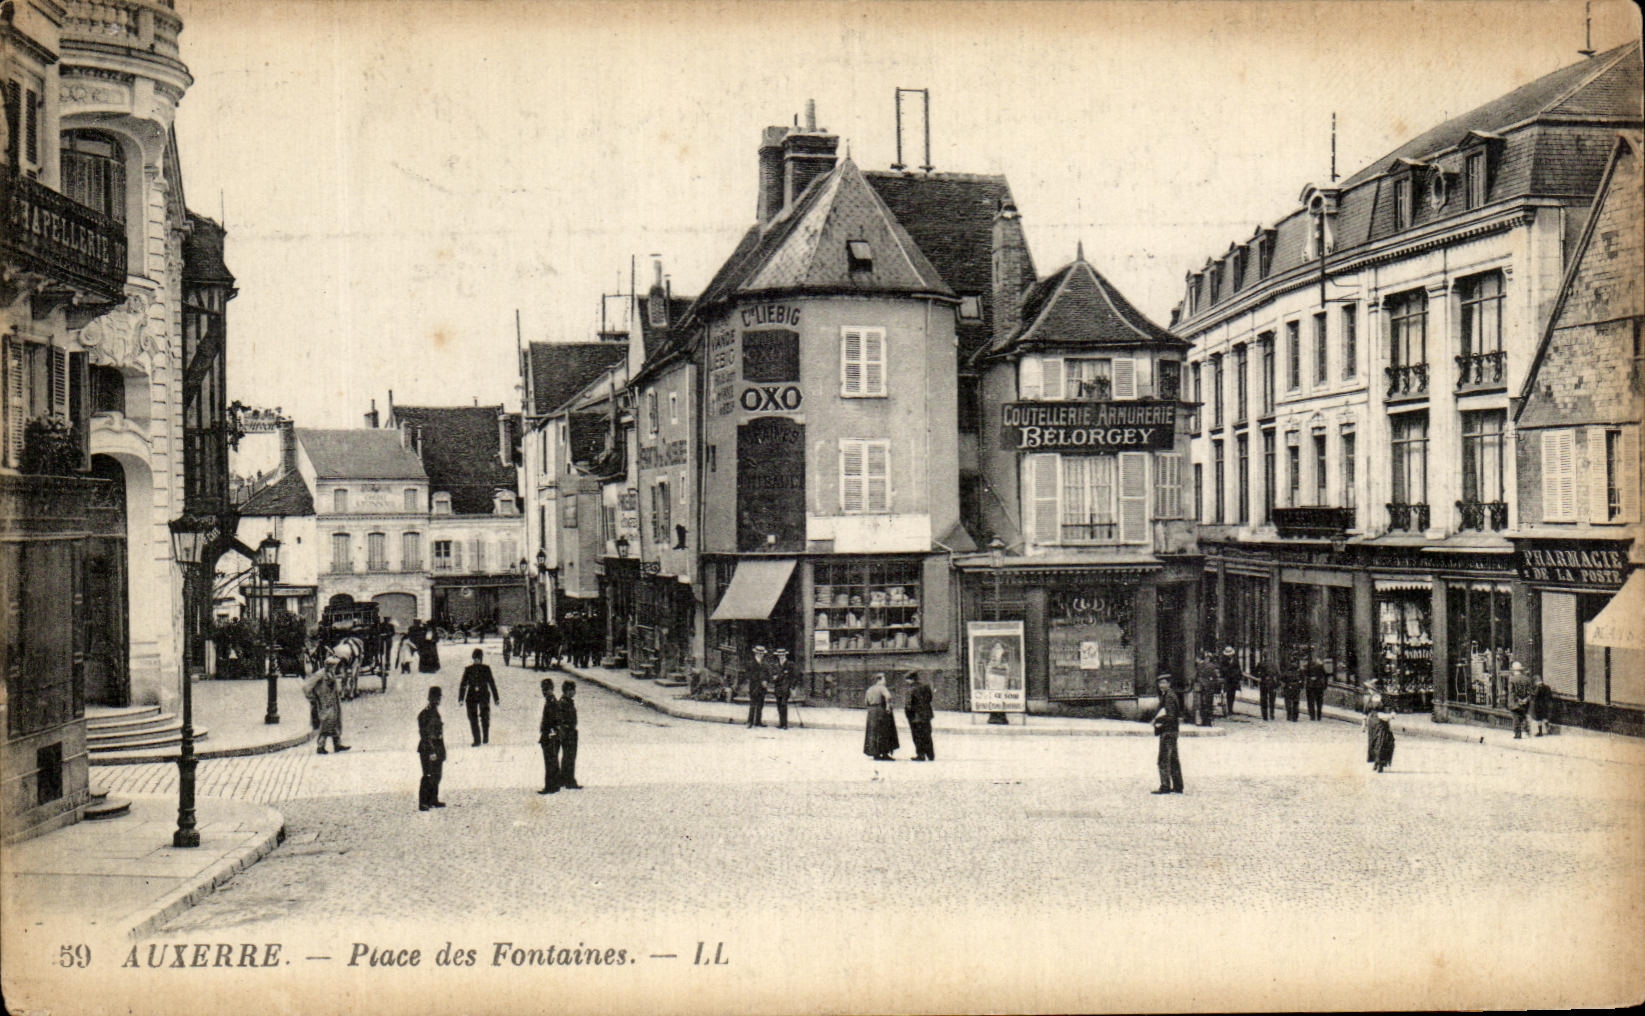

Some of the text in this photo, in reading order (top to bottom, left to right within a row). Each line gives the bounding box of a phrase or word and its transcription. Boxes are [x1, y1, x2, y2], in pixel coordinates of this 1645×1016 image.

[755, 304, 801, 326] LIEBIG
[740, 386, 803, 411] OXO
[1003, 404, 1175, 428] COUTELLERIE ARMURERIE
[1522, 549, 1623, 569] PHARMACIE
[1532, 567, 1623, 583] DE LA POSTE
